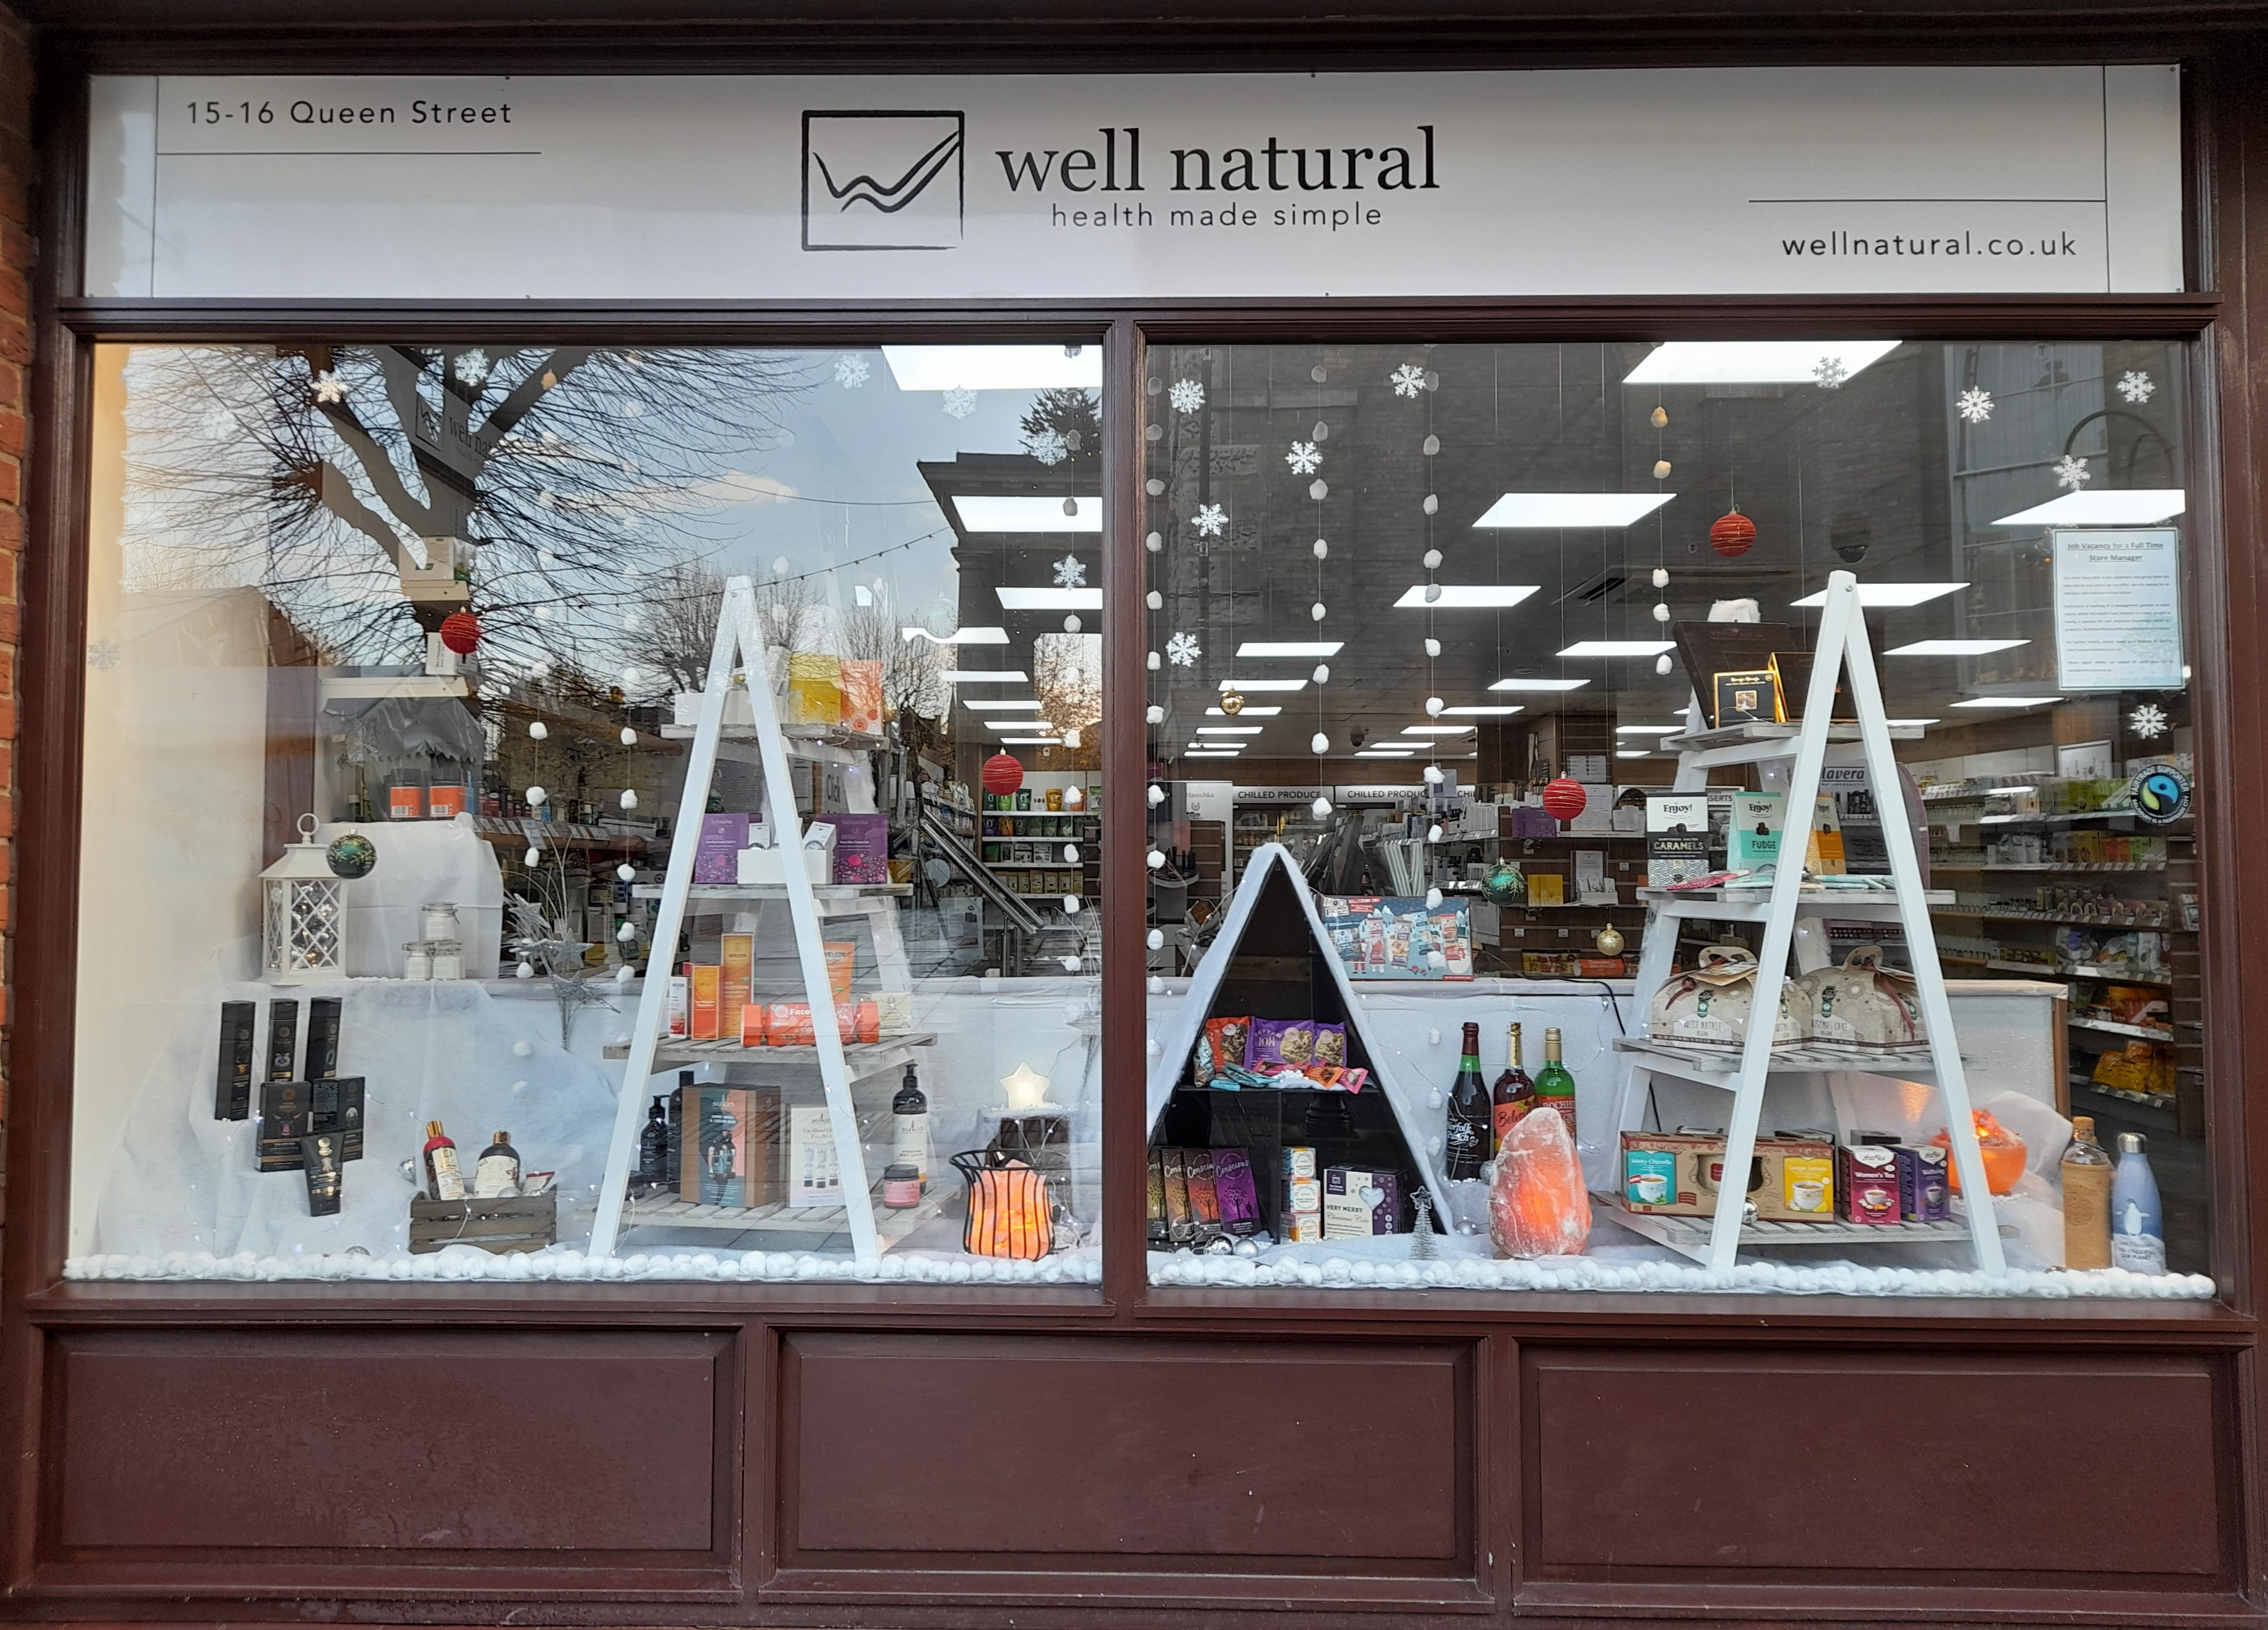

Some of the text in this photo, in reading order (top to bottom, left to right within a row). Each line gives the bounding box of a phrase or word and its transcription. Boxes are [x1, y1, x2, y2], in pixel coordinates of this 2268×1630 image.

[188, 100, 512, 125] 15-16 Queen Street
[995, 125, 1441, 193] well natural
[1053, 201, 1382, 232] health made simple
[1782, 230, 2077, 256] wellnatural.co.uk
[2082, 542, 2110, 550] Vacancy
[1822, 767, 1865, 779] lavera
[2131, 765, 2190, 796] FAIRTRADE SUPPORTER
[1663, 804, 1692, 813] Enjoy!
[1749, 804, 1772, 812] Enjoy!
[1653, 842, 1704, 850] CARAMELS
[1752, 841, 1776, 849] FUDGE
[713, 1093, 735, 1108] sukin
[901, 1120, 923, 1132] sukin
[1449, 1122, 1473, 1132] orfolk
[1216, 1160, 1249, 1178] Conscious
